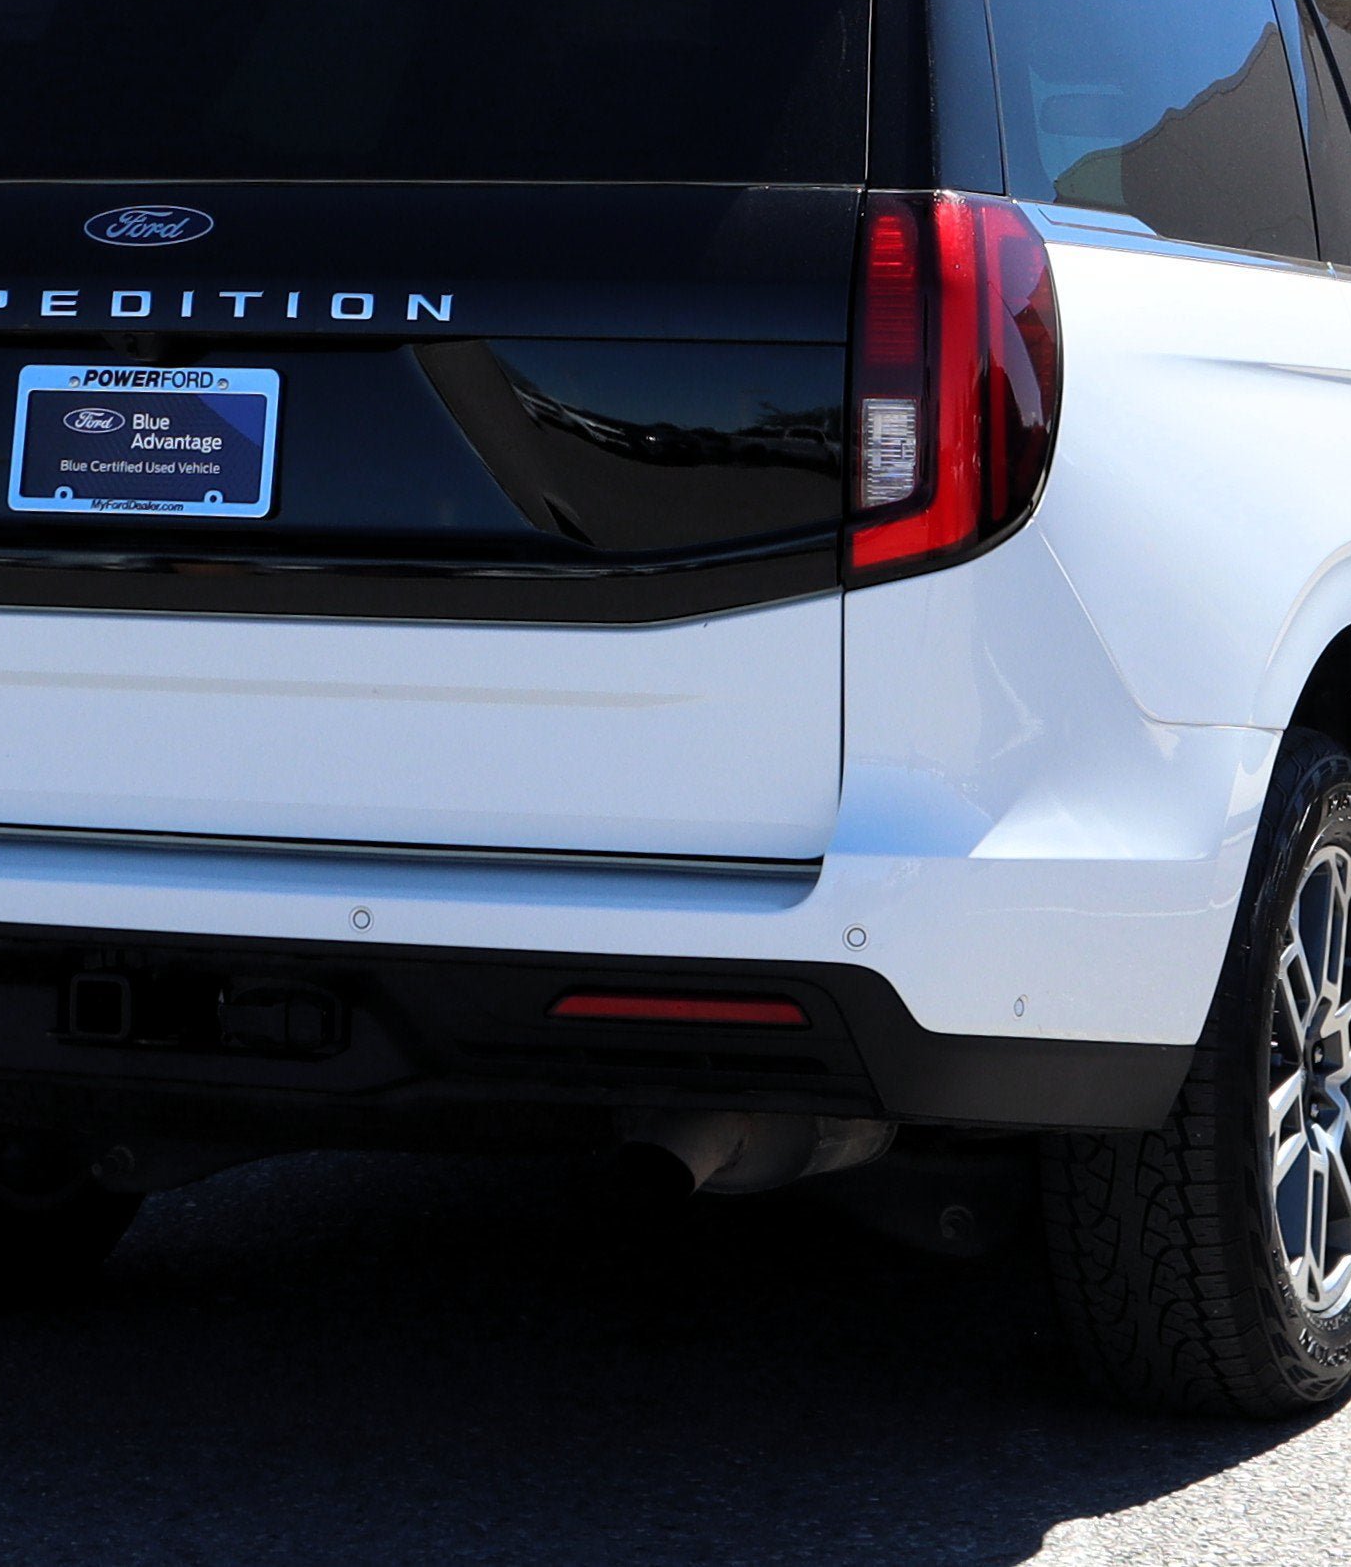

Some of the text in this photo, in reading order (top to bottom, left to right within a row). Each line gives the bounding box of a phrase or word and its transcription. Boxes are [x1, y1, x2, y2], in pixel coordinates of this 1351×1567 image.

[105, 208, 189, 240] Ford
[83, 369, 214, 389] POWERFORD
[75, 411, 170, 430] Ford Blue
[130, 433, 223, 453] Advantage
[60, 459, 221, 474] Blue Certified Used Vehicle
[90, 498, 184, 512] MyFordDealer.com
